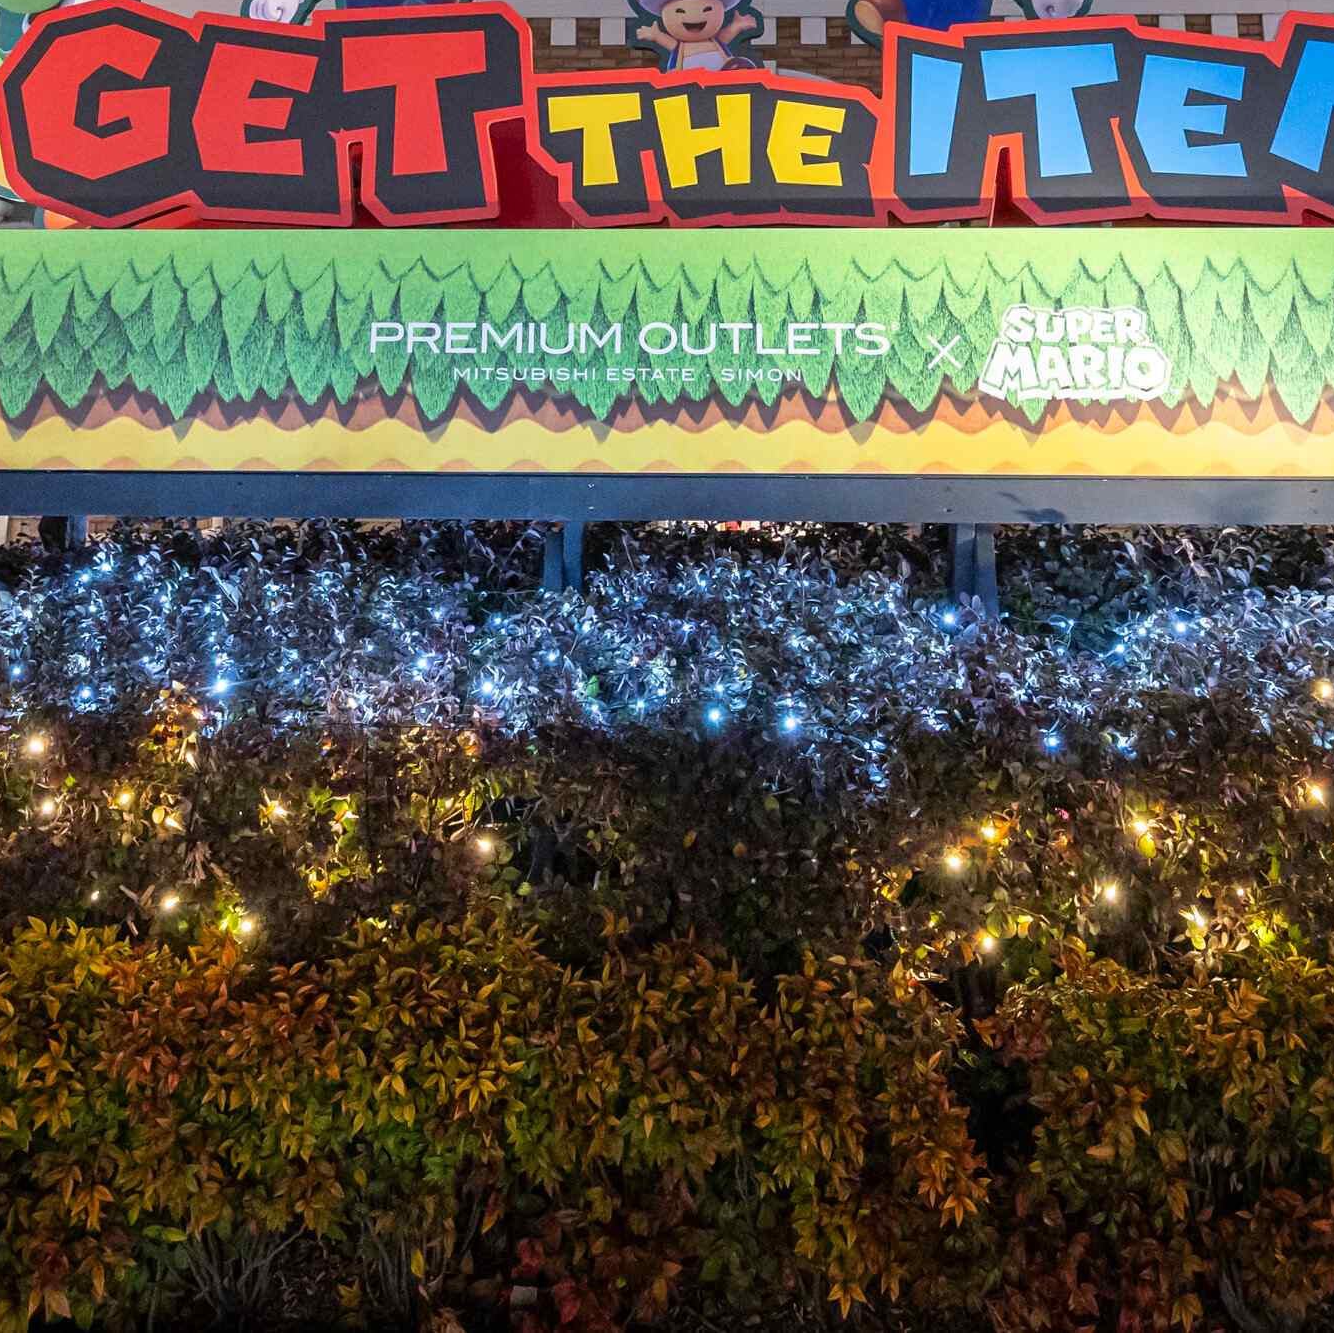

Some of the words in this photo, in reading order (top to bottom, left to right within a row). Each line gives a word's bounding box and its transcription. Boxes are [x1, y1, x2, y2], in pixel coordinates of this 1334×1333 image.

[19, 22, 487, 182] GET
[548, 91, 847, 188] THE
[370, 322, 622, 355] PREMIUM
[638, 322, 891, 355] OUTLETS
[1002, 304, 1146, 344] SUPER
[453, 367, 597, 382] MITSUBISHI
[606, 368, 695, 382] ESTATE
[720, 368, 803, 382] SIMON
[980, 340, 1171, 399] MARIO
